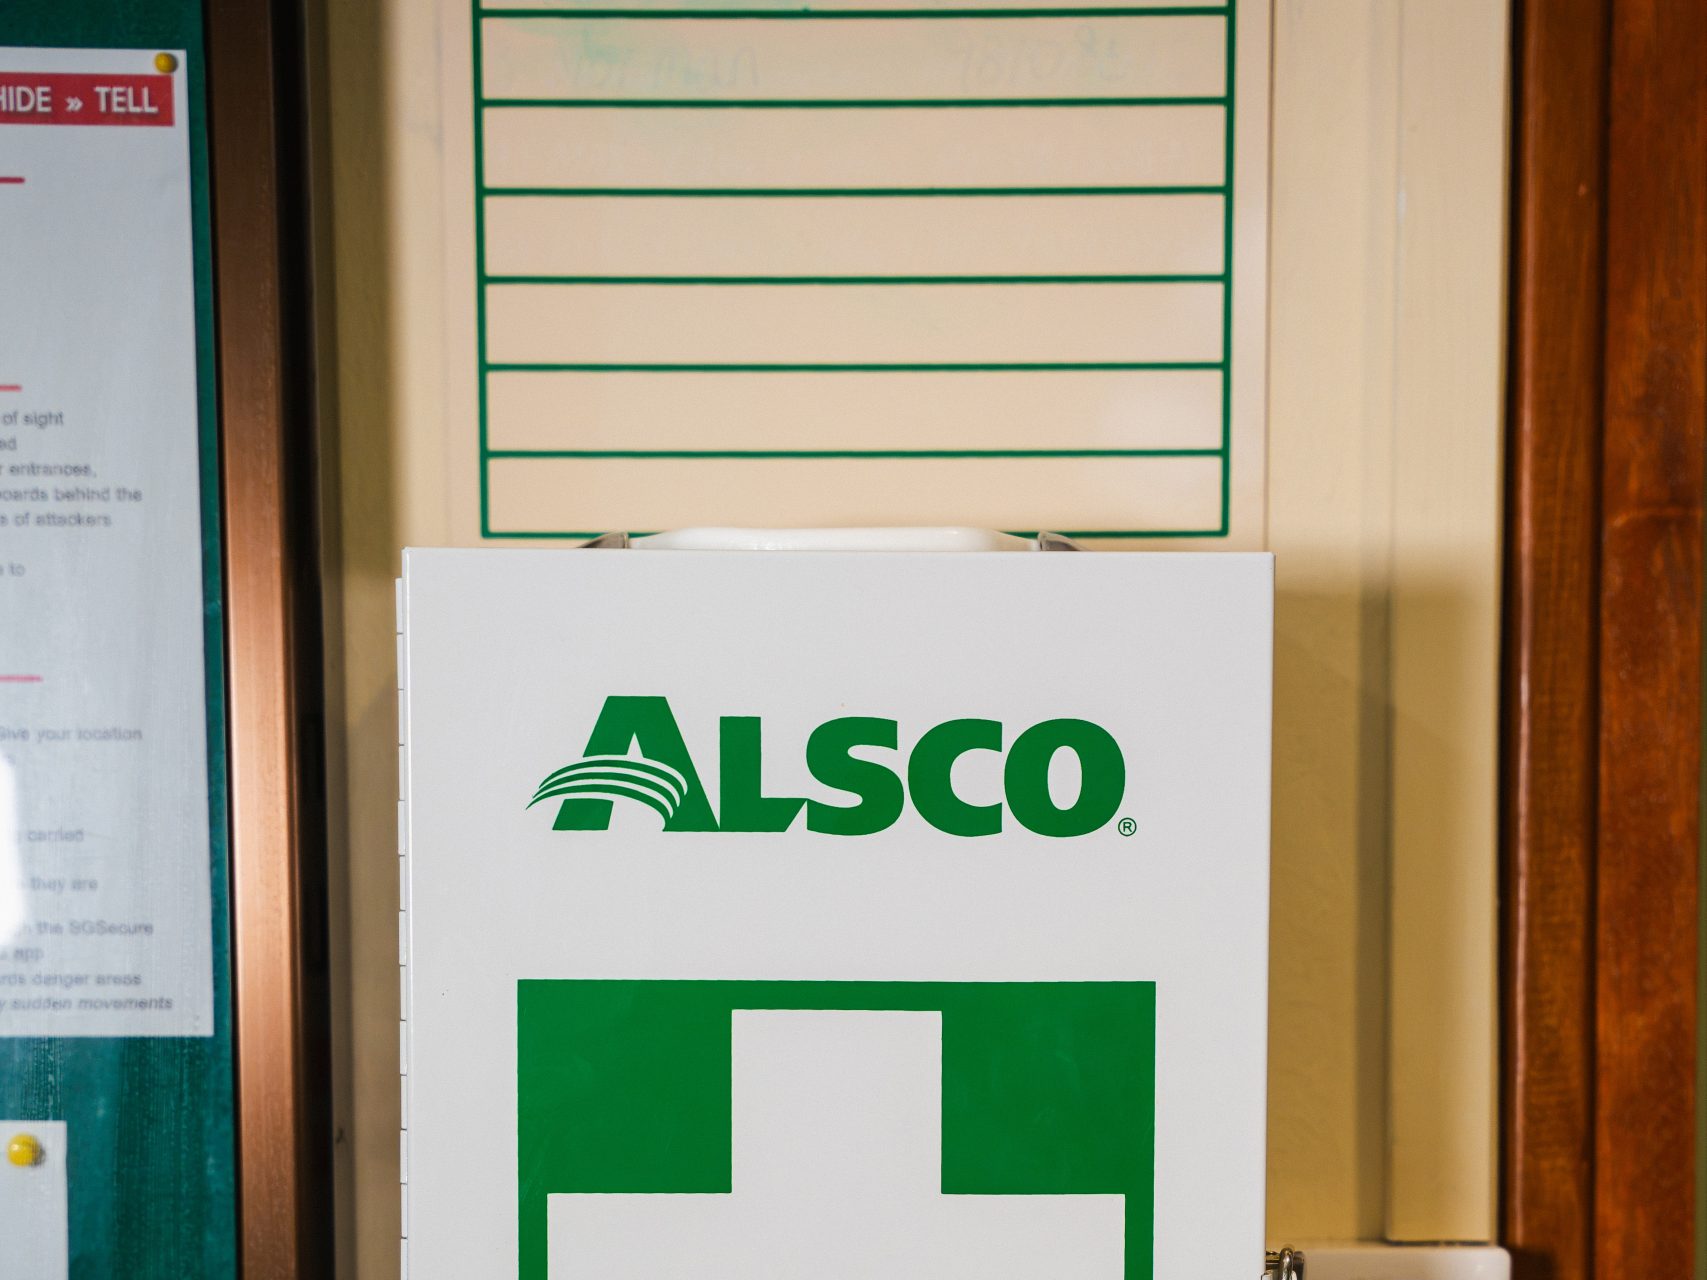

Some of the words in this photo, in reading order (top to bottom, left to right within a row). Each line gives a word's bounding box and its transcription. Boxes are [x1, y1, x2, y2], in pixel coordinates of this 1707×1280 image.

[94, 86, 159, 113] TELL
[3, 410, 18, 426] of
[23, 410, 64, 430] sight
[55, 487, 111, 502] behind
[116, 487, 143, 502] the
[15, 512, 30, 527] of
[36, 512, 112, 528] attackers
[36, 728, 71, 744] your
[77, 726, 143, 742] location
[525, 696, 1126, 838] ALSCO
[69, 920, 154, 936] SGSecure
[32, 972, 89, 988] danger
[12, 997, 72, 1011] sudden
[78, 997, 173, 1011] movements
